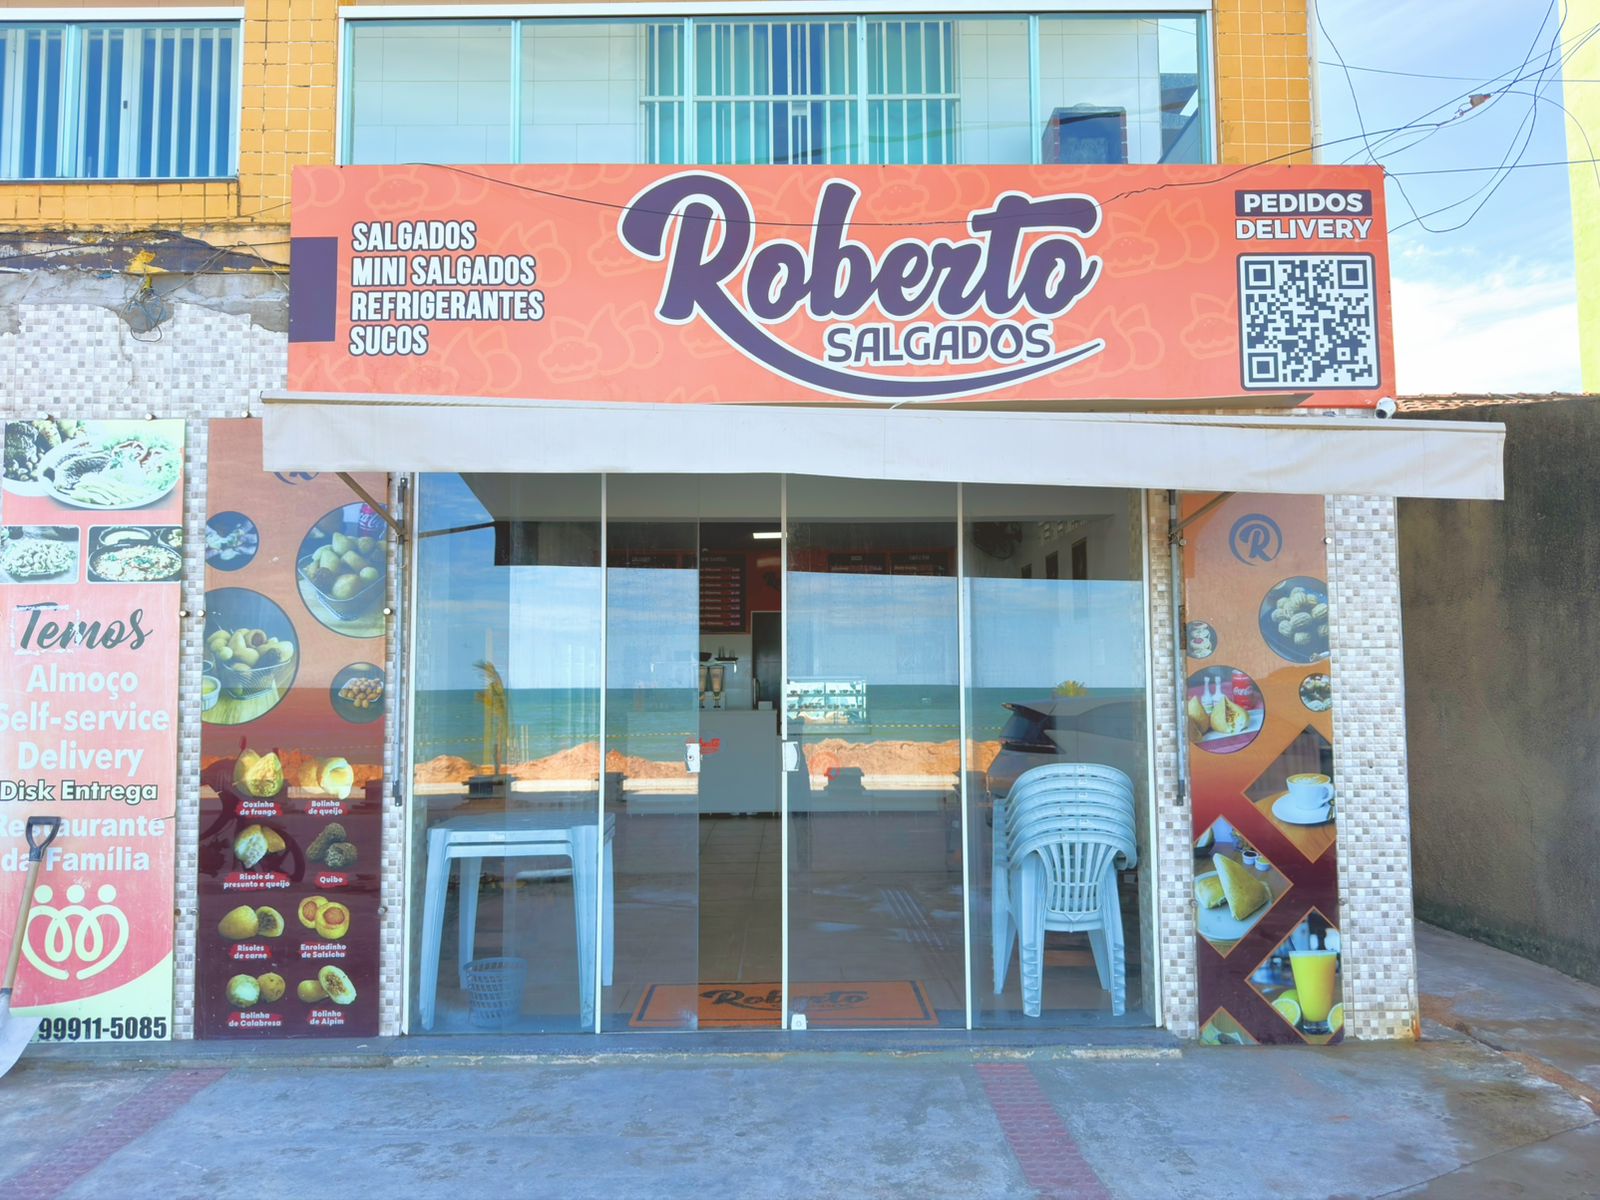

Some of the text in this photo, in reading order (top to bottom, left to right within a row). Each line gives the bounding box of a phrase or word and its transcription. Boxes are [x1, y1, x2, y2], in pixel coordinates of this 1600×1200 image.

[1243, 193, 1363, 213] PEDIDOS
[351, 220, 477, 252] SALGADOS
[1235, 218, 1373, 240] DELIVERY
[351, 255, 536, 287] MINI SALGADOS
[617, 170, 1105, 403] Roberto
[350, 290, 545, 321] REFRIGERANTES
[349, 324, 429, 357] SUCOS
[825, 321, 1052, 365] SALGADOS
[16, 602, 153, 650] Temos
[26, 663, 139, 700] Almoço
[18, 739, 144, 777] Delivery
[0, 779, 158, 805] Disk Entrega
[250, 809, 277, 817] frango
[319, 808, 343, 816] queijo
[46, 847, 150, 872] Família
[223, 881, 258, 889] presunto
[265, 881, 290, 889] queijo
[319, 876, 343, 884] Quibe
[38, 1016, 167, 1041] 99911-5085
